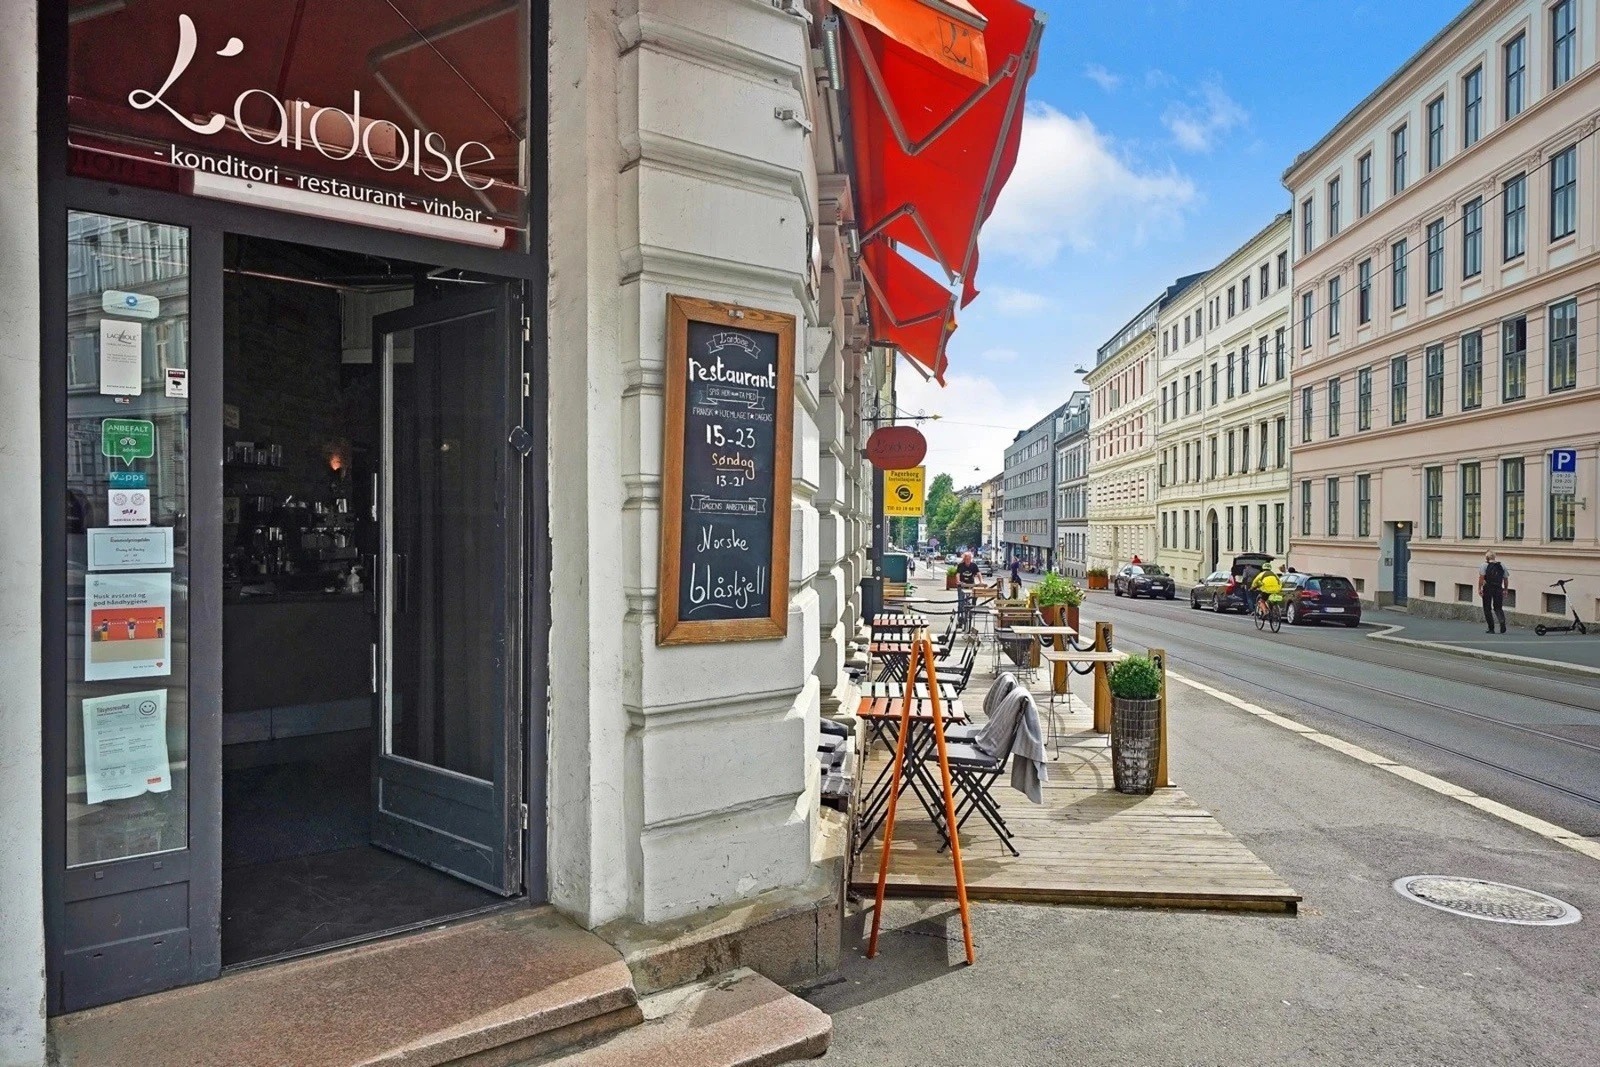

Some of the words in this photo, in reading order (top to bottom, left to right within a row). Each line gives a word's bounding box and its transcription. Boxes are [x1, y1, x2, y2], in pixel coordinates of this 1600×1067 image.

[128, 13, 495, 190] L'ardoise
[170, 144, 279, 185] konditori
[299, 173, 405, 210] restaurant
[422, 197, 482, 223] vinbar
[688, 356, 776, 389] restaurant
[708, 388, 720, 396] SPIS
[746, 392, 757, 401] MED
[107, 424, 149, 433] ANBEFALT
[754, 413, 773, 422] DAGENS
[711, 452, 755, 480] Søndag
[1557, 452, 1571, 470] P
[701, 502, 723, 510] DAGENS
[697, 524, 749, 553] Norske
[689, 563, 766, 610] blåskjell
